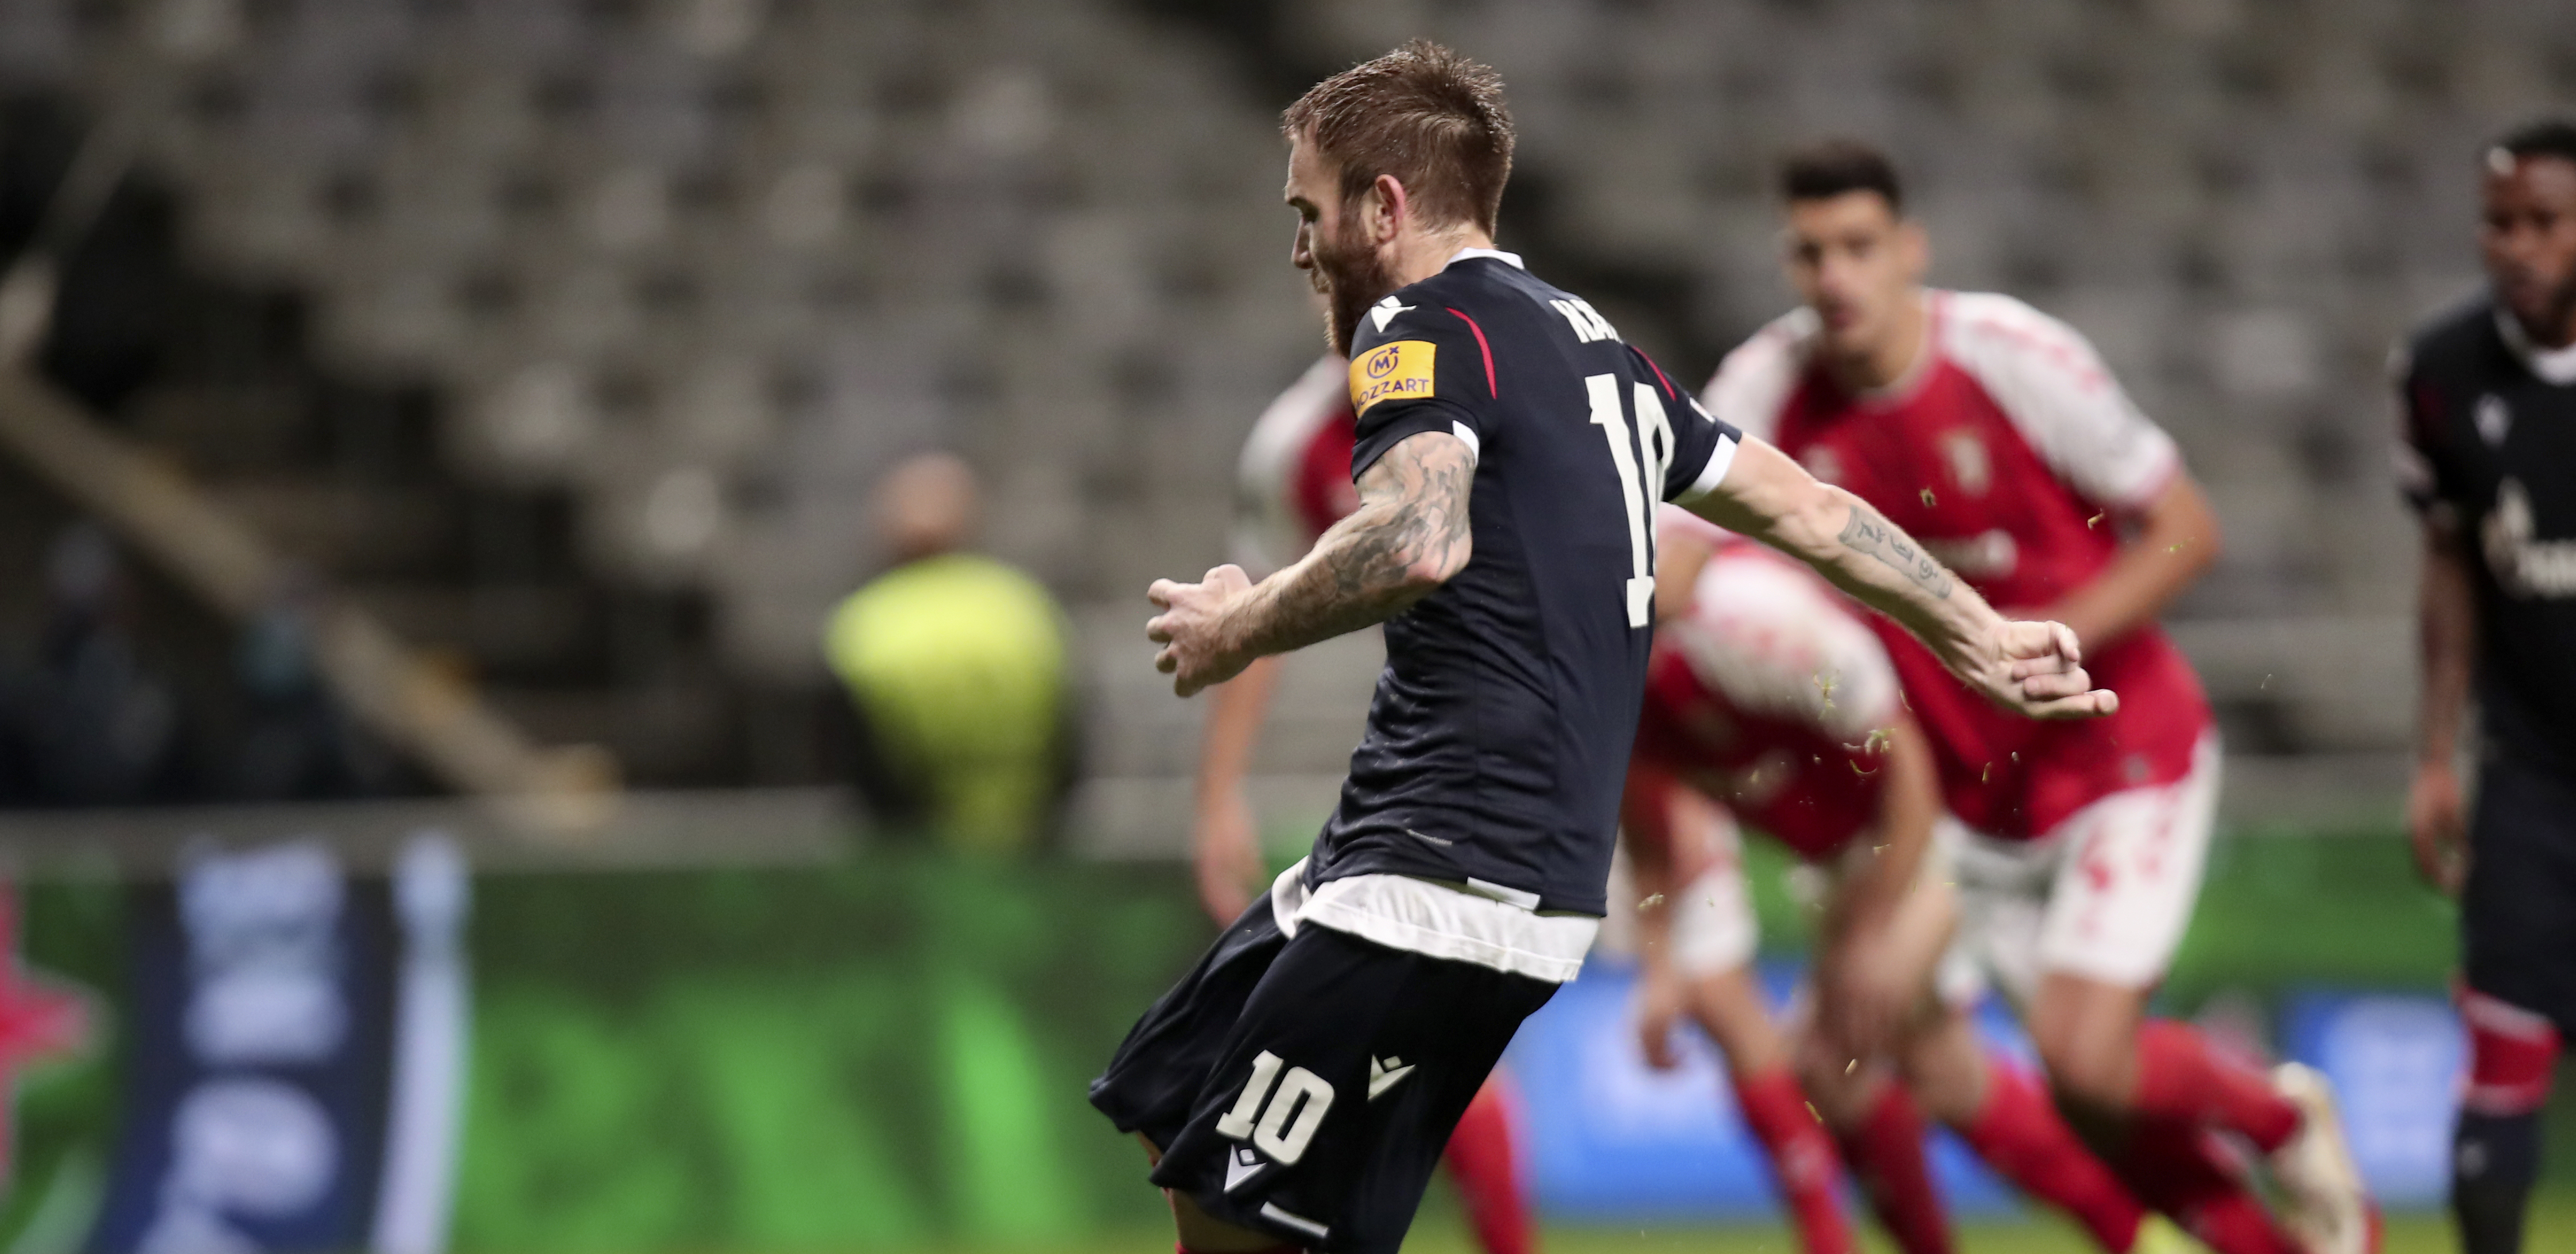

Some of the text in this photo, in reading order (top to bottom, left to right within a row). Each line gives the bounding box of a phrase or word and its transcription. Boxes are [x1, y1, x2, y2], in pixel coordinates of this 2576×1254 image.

[1549, 299, 1623, 343] KA
[1584, 373, 1675, 628] 10
[1215, 1049, 1334, 1166] 10
